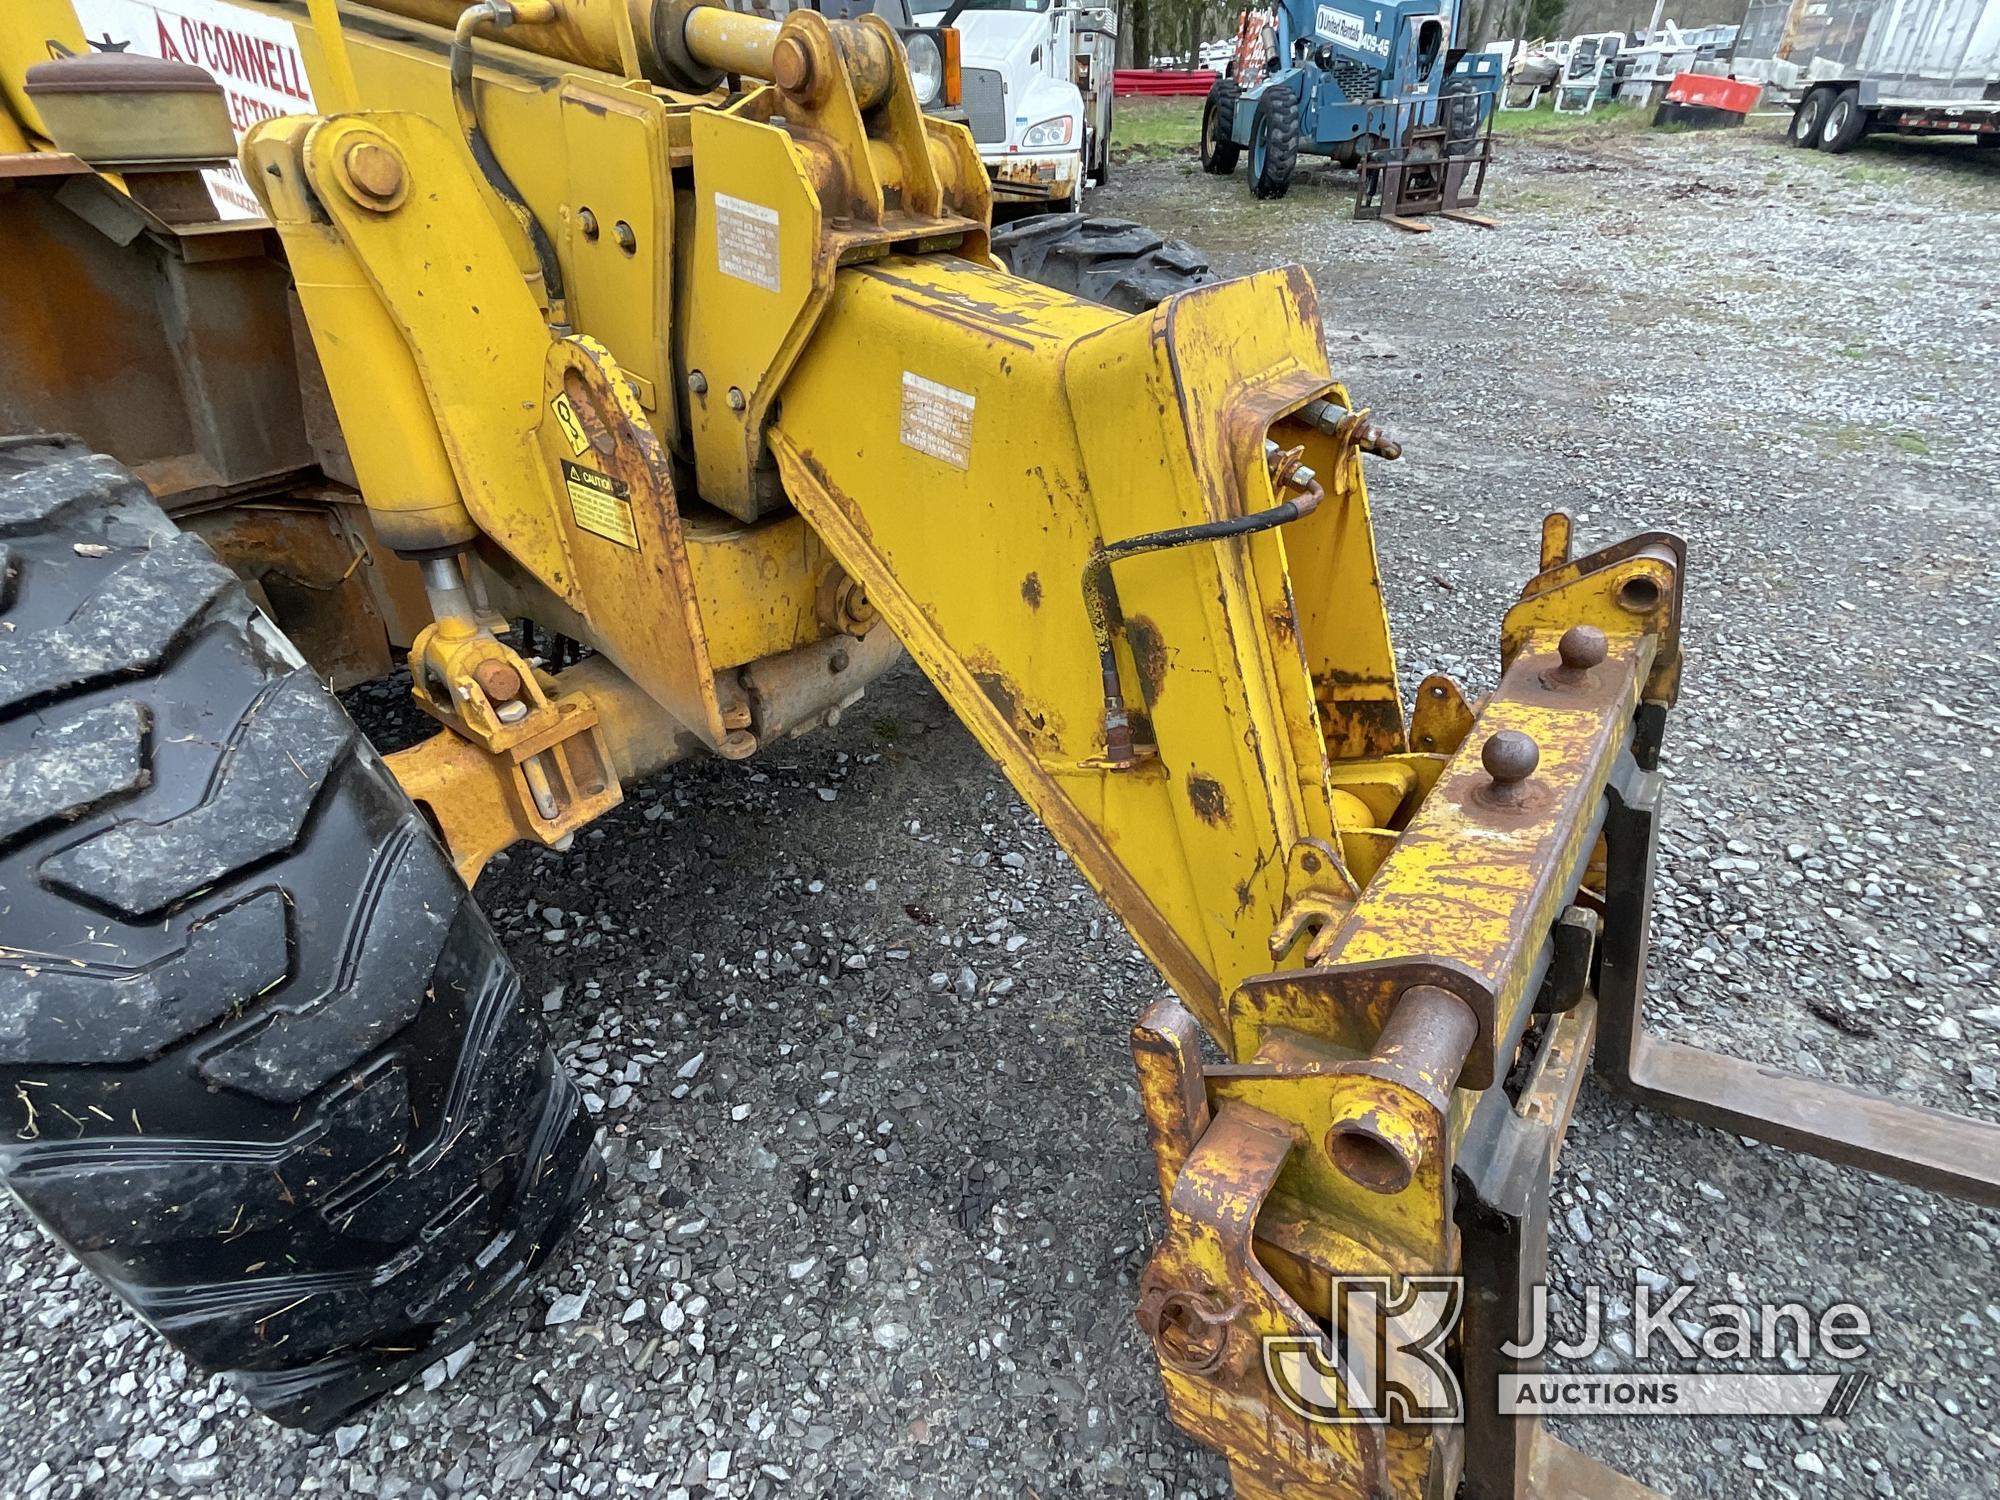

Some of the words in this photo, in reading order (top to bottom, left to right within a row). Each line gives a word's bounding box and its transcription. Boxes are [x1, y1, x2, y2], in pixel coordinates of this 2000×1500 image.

[1323, 13, 1341, 35] United
[1341, 19, 1360, 42] Rentals
[180, 15, 310, 101] O'CONNELL
[1362, 33, 1390, 57] 409-45
